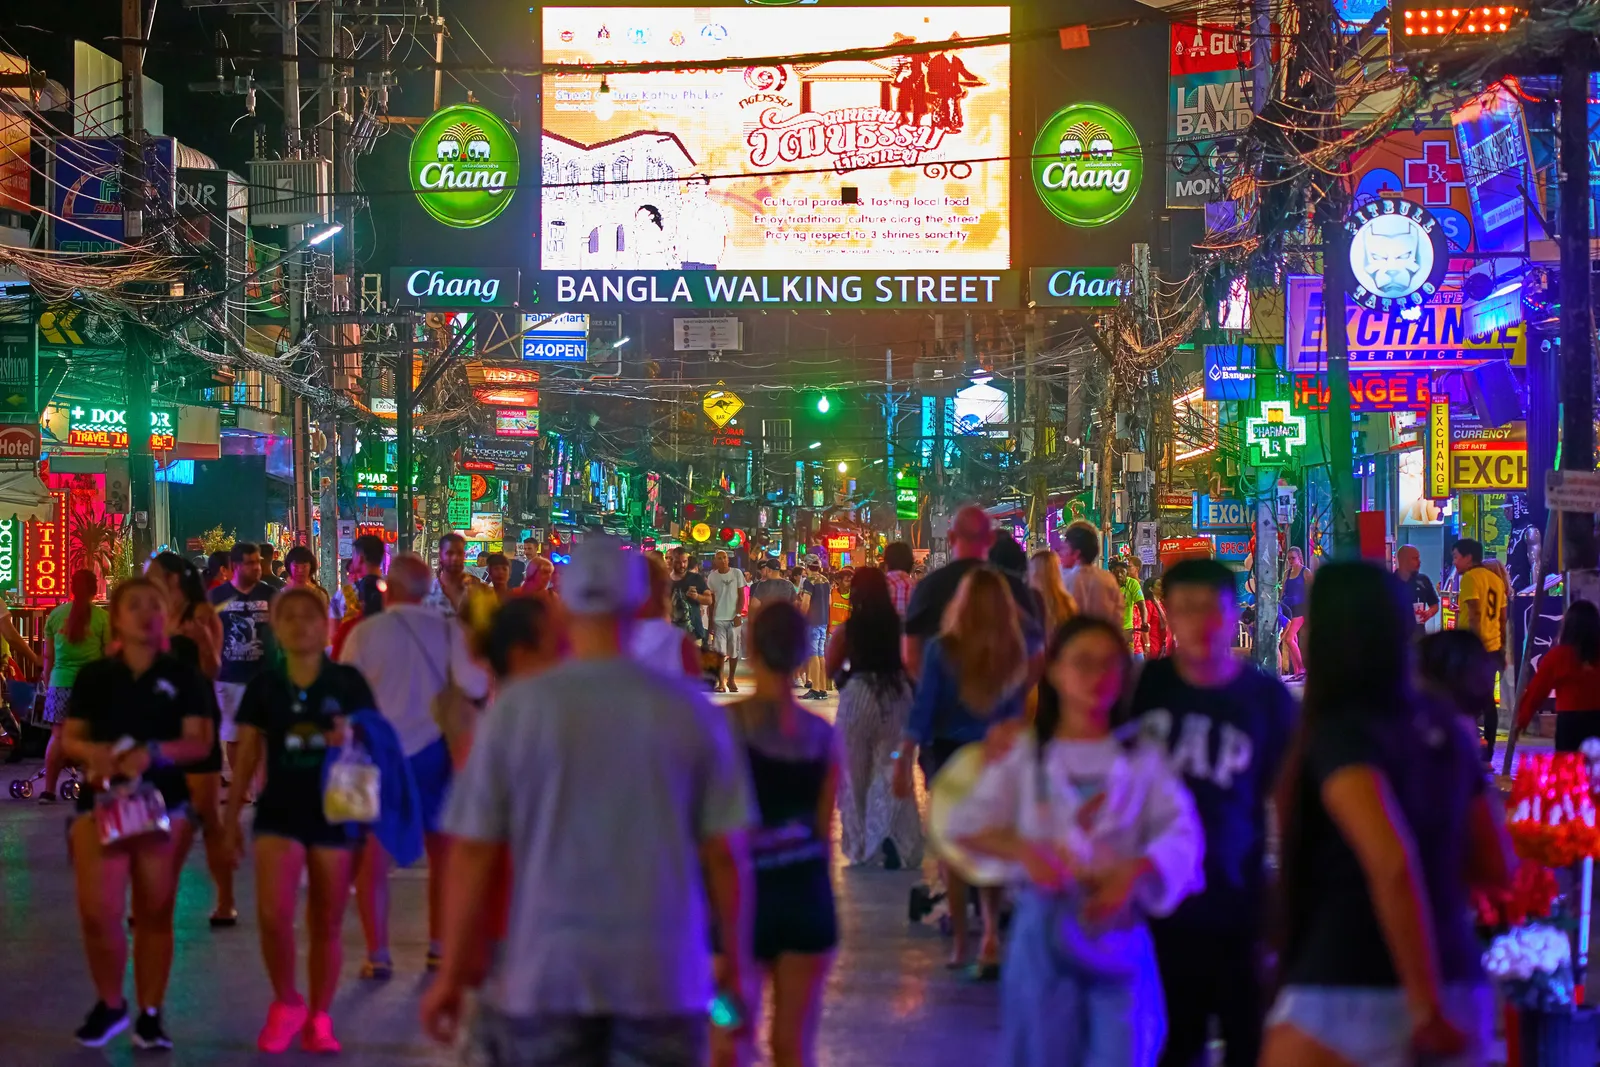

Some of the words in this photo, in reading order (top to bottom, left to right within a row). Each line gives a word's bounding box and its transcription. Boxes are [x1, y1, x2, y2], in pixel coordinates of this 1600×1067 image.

[1177, 81, 1254, 116] LIVE
[1176, 110, 1254, 136] BAND
[419, 162, 508, 194] Chang
[1042, 162, 1131, 194] Chang
[763, 197, 808, 206] Cultural
[812, 197, 851, 209] para
[871, 197, 910, 209] Tasting
[914, 197, 940, 206] local
[944, 197, 970, 206] food
[754, 214, 784, 226] Enjoy
[848, 214, 887, 223] culture
[926, 214, 944, 223] the
[947, 214, 979, 223] street
[810, 230, 851, 241] respect
[855, 230, 866, 239] to
[870, 230, 877, 239] 3
[882, 230, 920, 239] shrines
[924, 230, 968, 241] sanctity
[407, 269, 500, 303] Chang
[557, 275, 693, 302] BANGLA
[705, 275, 863, 302] WALKING
[875, 275, 1001, 302] STREET
[1048, 269, 1133, 298] Chan
[1353, 282, 1436, 312] TATTOO
[1427, 292, 1464, 303] ATE
[1350, 350, 1464, 361] SERVICE
[76, 432, 110, 443] TRAVEL
[1253, 424, 1300, 438] PHARMACY
[1453, 429, 1511, 439] CURRENCY
[1436, 405, 1445, 495] EXCHANGE
